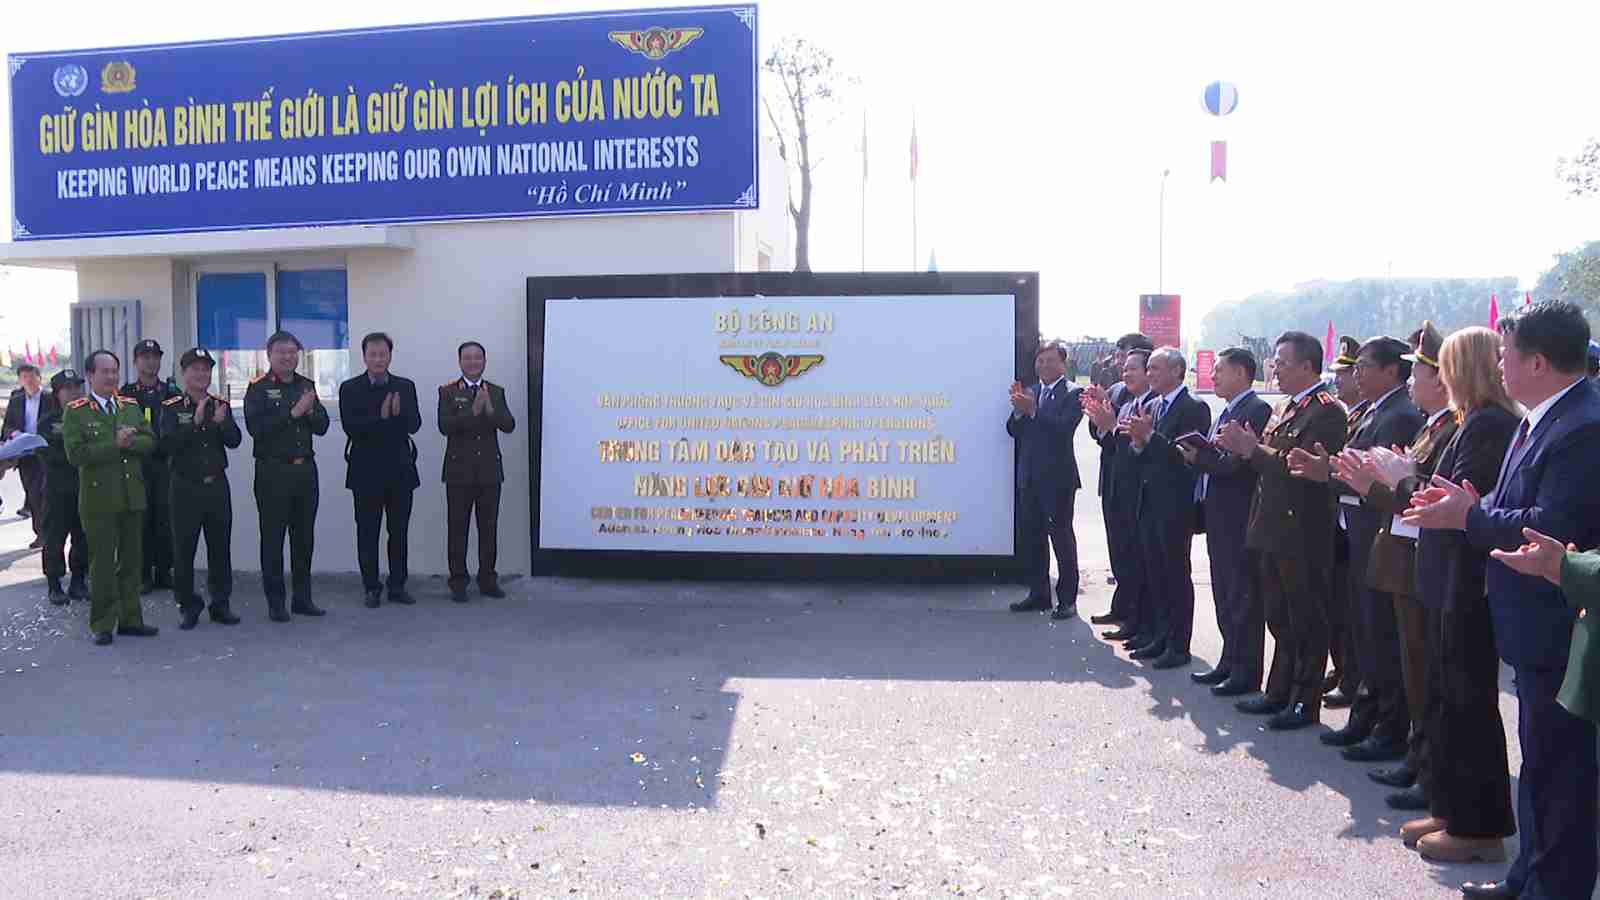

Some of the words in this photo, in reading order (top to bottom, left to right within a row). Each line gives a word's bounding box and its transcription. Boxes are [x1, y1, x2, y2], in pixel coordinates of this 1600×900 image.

[39, 106, 77, 154] GIỮ
[81, 103, 118, 152] GÌN
[125, 99, 168, 149] HÒA
[174, 97, 226, 146] BÌNH
[232, 87, 275, 142] THẾ
[280, 88, 324, 140] GIỚI
[332, 86, 360, 136] LÀ
[367, 82, 408, 134] GIỮ
[413, 80, 454, 131] GÌN
[462, 81, 498, 136] LỢI
[506, 75, 547, 127] ÍCH
[555, 65, 605, 123] CỦA
[613, 67, 682, 120] NƯỚC
[691, 73, 719, 117] TA
[57, 166, 127, 199] KEEPING
[132, 163, 190, 195] WORLD
[195, 159, 249, 191] PEACE
[254, 155, 316, 187] MEANS
[322, 150, 398, 184] KEEPING
[404, 147, 441, 180] OUR
[446, 145, 491, 177] OWN
[497, 140, 587, 176] NATIONAL
[594, 136, 699, 171] INTERESTS
[575, 181, 609, 203] Chí
[806, 311, 833, 334] AN
[667, 437, 710, 464] TÂM
[839, 436, 890, 463] PHÁT
[867, 474, 917, 499] BÌNH
